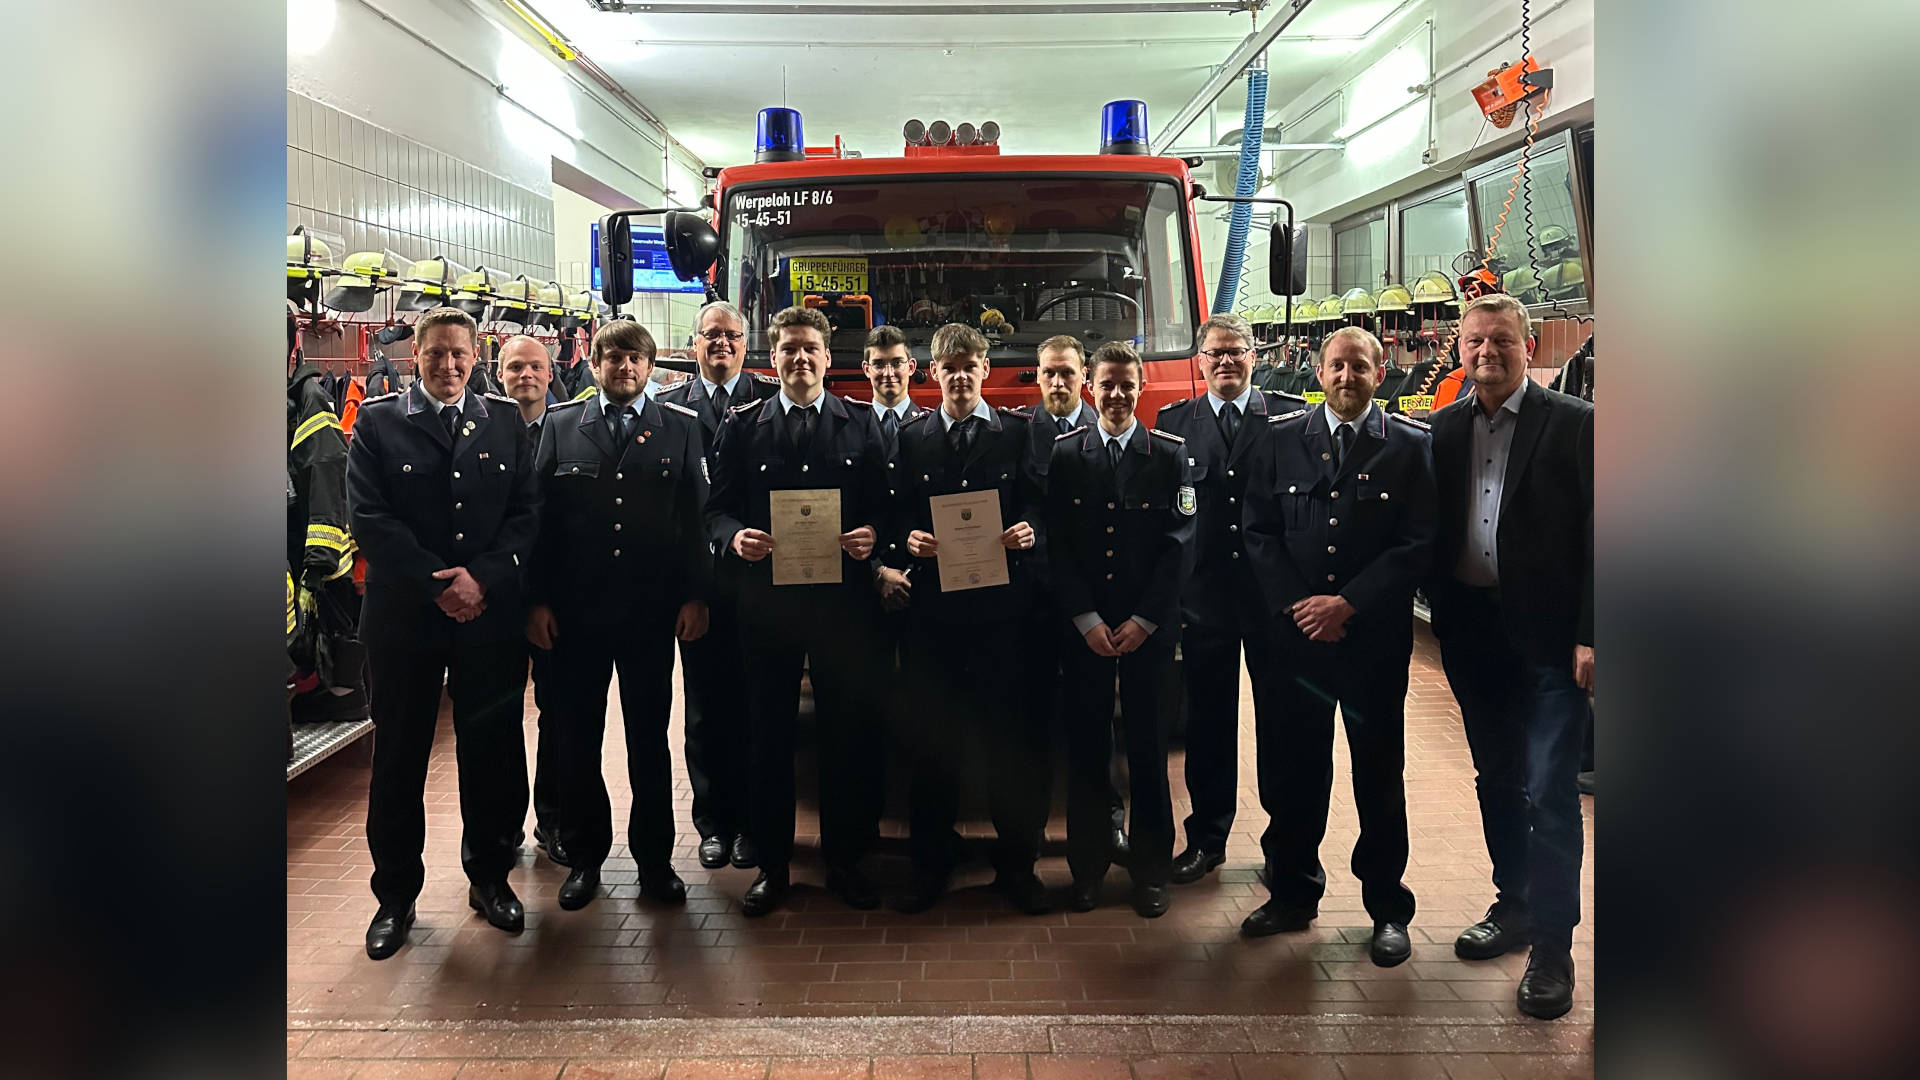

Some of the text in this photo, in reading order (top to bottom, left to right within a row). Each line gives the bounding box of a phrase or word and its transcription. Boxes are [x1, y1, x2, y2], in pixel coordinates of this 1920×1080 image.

[735, 190, 833, 211] Werpeloh LF 8/6
[735, 210, 791, 228] 15-45-51
[792, 260, 866, 273] GRUPPENFÜHRER
[797, 275, 861, 291] 15-45-51
